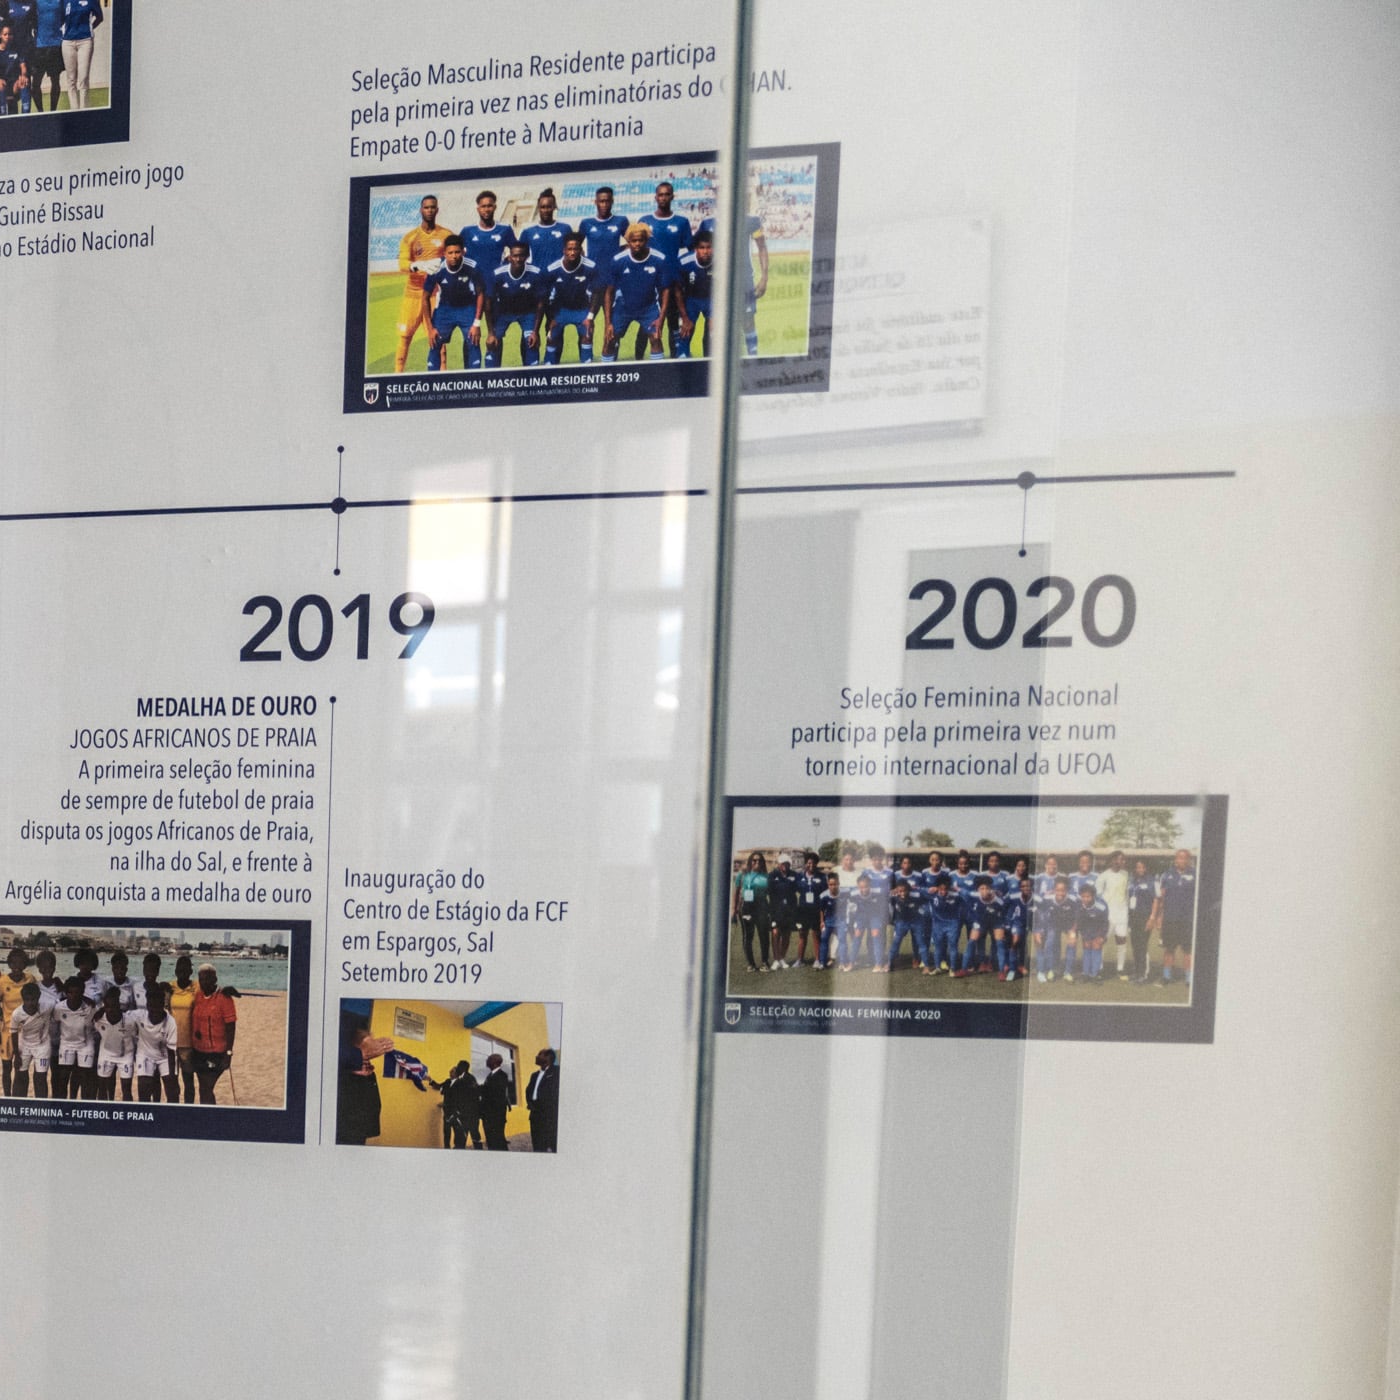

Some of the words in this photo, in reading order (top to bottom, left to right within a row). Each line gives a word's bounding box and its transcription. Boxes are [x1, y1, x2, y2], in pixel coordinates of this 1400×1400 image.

[351, 66, 421, 94] Seleção
[427, 57, 522, 85] Masculina
[529, 49, 624, 77] Residente
[631, 42, 715, 75] participa
[350, 134, 419, 162] Empate
[424, 128, 455, 152] 0-0
[460, 125, 516, 149] frente
[522, 123, 532, 144] à
[539, 115, 643, 143] Mauritania
[20, 178, 30, 193] o
[34, 175, 62, 192] seu
[68, 164, 141, 196] primeiro
[144, 162, 184, 190] jogo
[386, 380, 429, 395] SELEÇÃO
[432, 379, 484, 391] NACIONAL
[487, 376, 548, 388] MASCULINA
[550, 373, 613, 385] RESIDENTES
[615, 371, 640, 383] 2019
[905, 574, 1136, 650] 2020
[239, 591, 435, 662] 2019
[136, 696, 226, 717] MEDALHA
[231, 696, 255, 716] DE
[261, 694, 317, 716] OURO
[836, 682, 917, 714] Seleção
[924, 685, 1020, 708] Feminina
[1027, 682, 1118, 707] Nacional
[69, 728, 128, 749] JOGOS
[132, 727, 231, 748] AFRICANOS
[237, 727, 259, 747] DE
[265, 726, 317, 747] PRAIA
[804, 754, 876, 776] torneio
[883, 751, 1017, 776] internacional
[1024, 751, 1049, 776] da
[1057, 752, 1115, 775] UFOA
[341, 960, 428, 983] Setembro
[433, 962, 482, 984] 2019
[749, 1004, 795, 1022] SELEÇÃO
[798, 1007, 854, 1018] NACIONAL
[857, 1008, 911, 1019] FEMININA
[913, 1009, 941, 1020] 2020
[19, 1106, 63, 1117] FEMININA
[71, 1108, 110, 1119] FUTEBOL
[112, 1110, 124, 1120] DE
[126, 1111, 154, 1121] PRAIA
